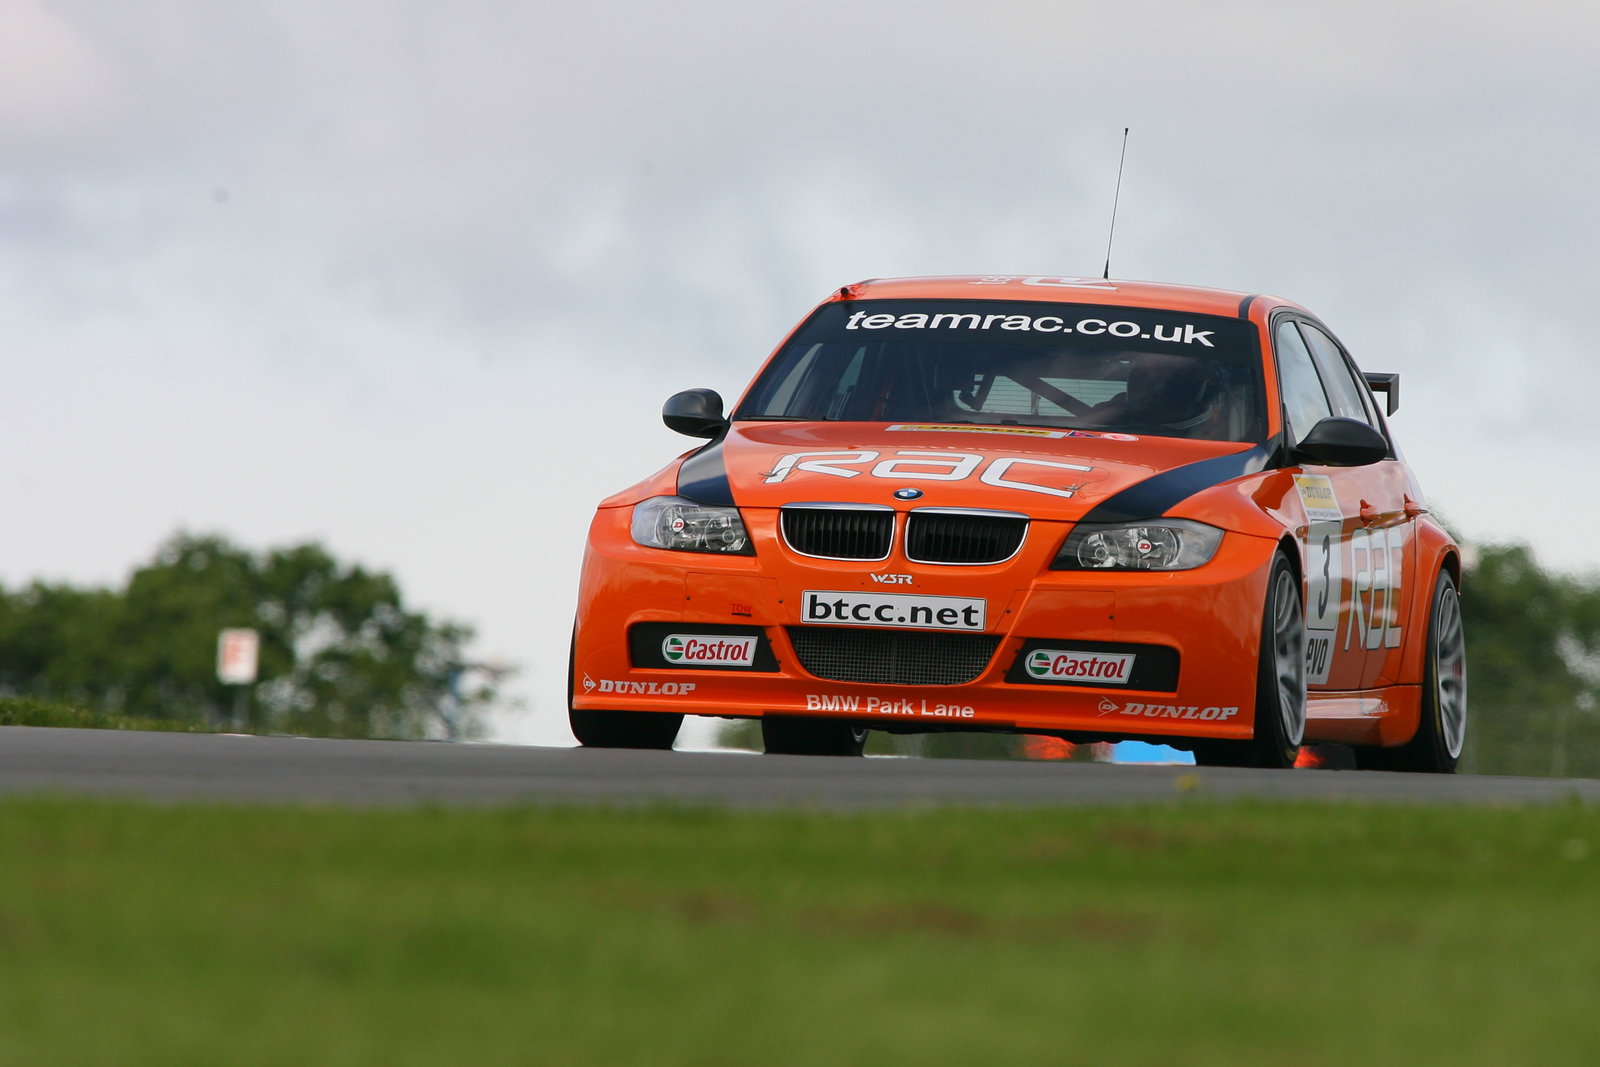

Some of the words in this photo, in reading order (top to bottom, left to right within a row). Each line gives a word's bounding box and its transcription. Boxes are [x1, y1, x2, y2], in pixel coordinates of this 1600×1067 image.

[845, 310, 1215, 348] teamrac.co.uk
[869, 573, 913, 584] WSR
[1318, 534, 1330, 619] 3
[808, 594, 979, 627] btcc.net
[685, 639, 750, 661] Castrol
[1306, 638, 1329, 675] evo
[1052, 655, 1127, 678] Castrol
[598, 679, 696, 695] DUNLOP
[806, 694, 860, 712] BMW
[867, 696, 914, 715] Park
[921, 699, 975, 718] Lane
[1120, 702, 1239, 721] DUNLOP
